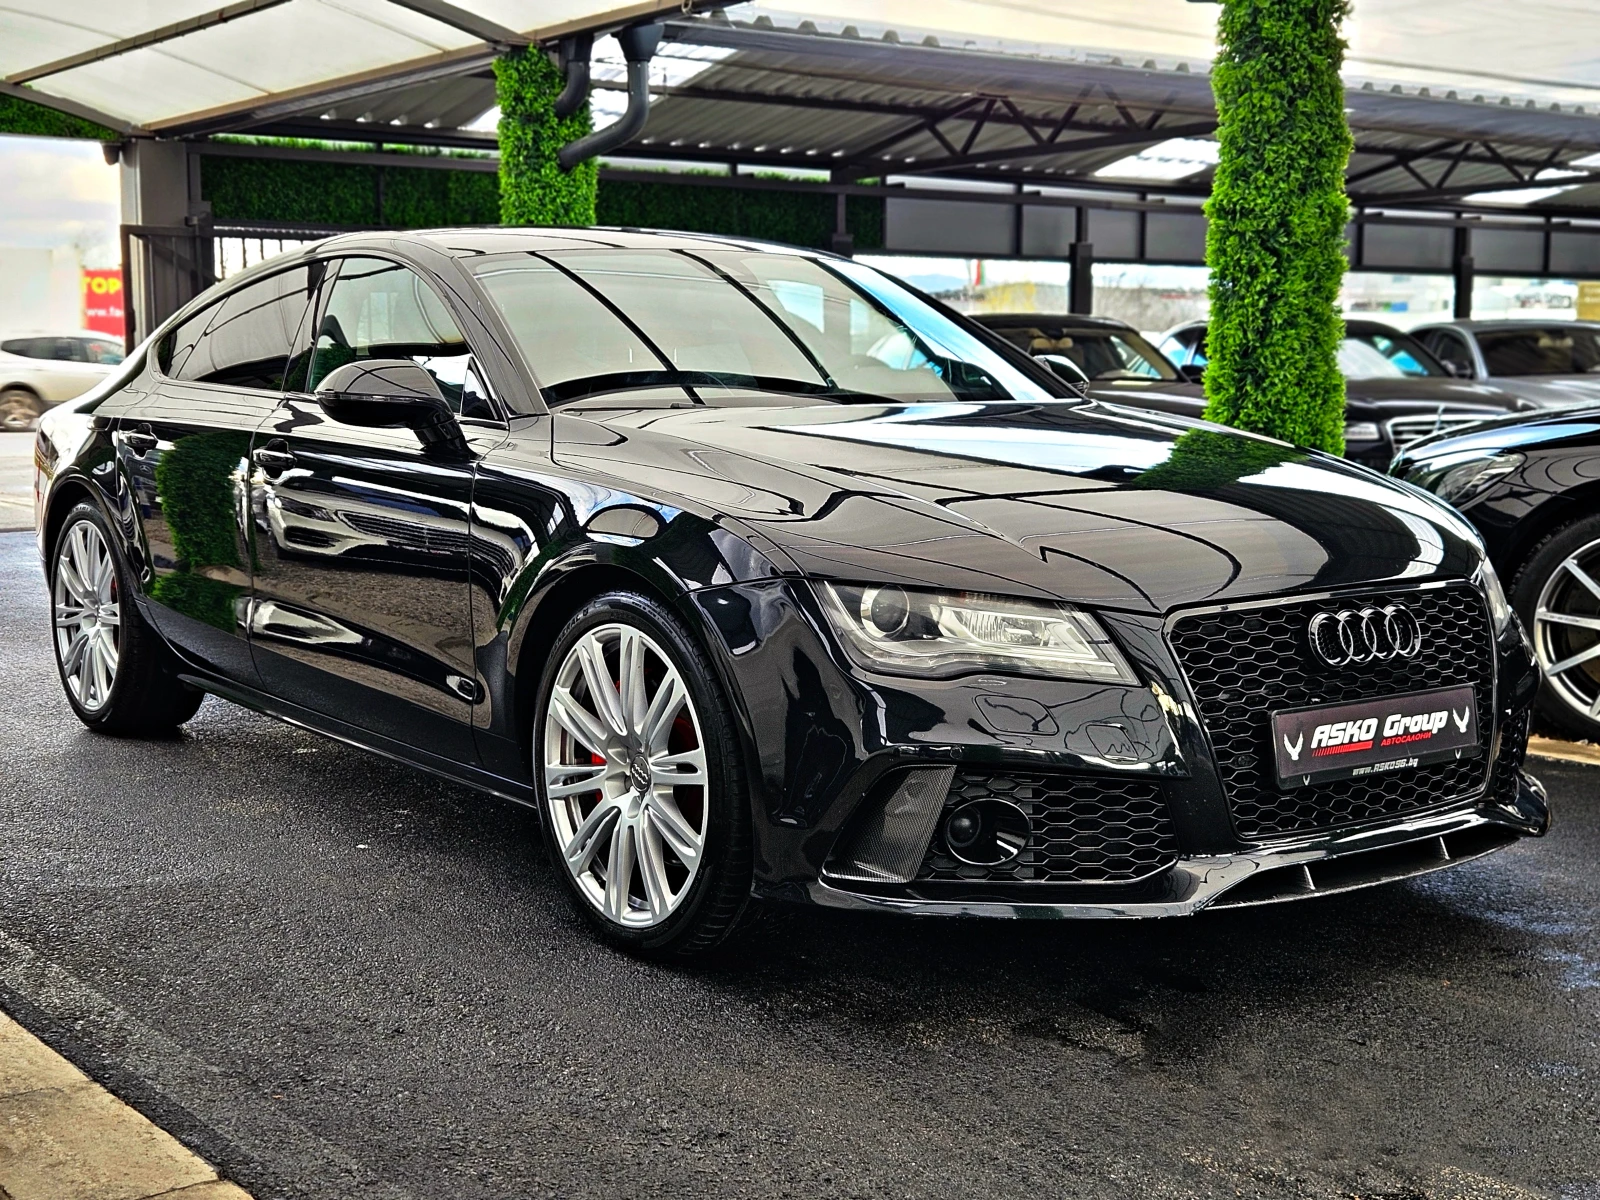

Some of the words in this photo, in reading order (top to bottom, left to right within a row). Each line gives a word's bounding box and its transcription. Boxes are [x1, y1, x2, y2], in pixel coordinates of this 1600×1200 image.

[1311, 718, 1378, 749] ASKO
[1383, 711, 1449, 737] Group
[1380, 731, 1432, 747] АВТОСАЛОНИ
